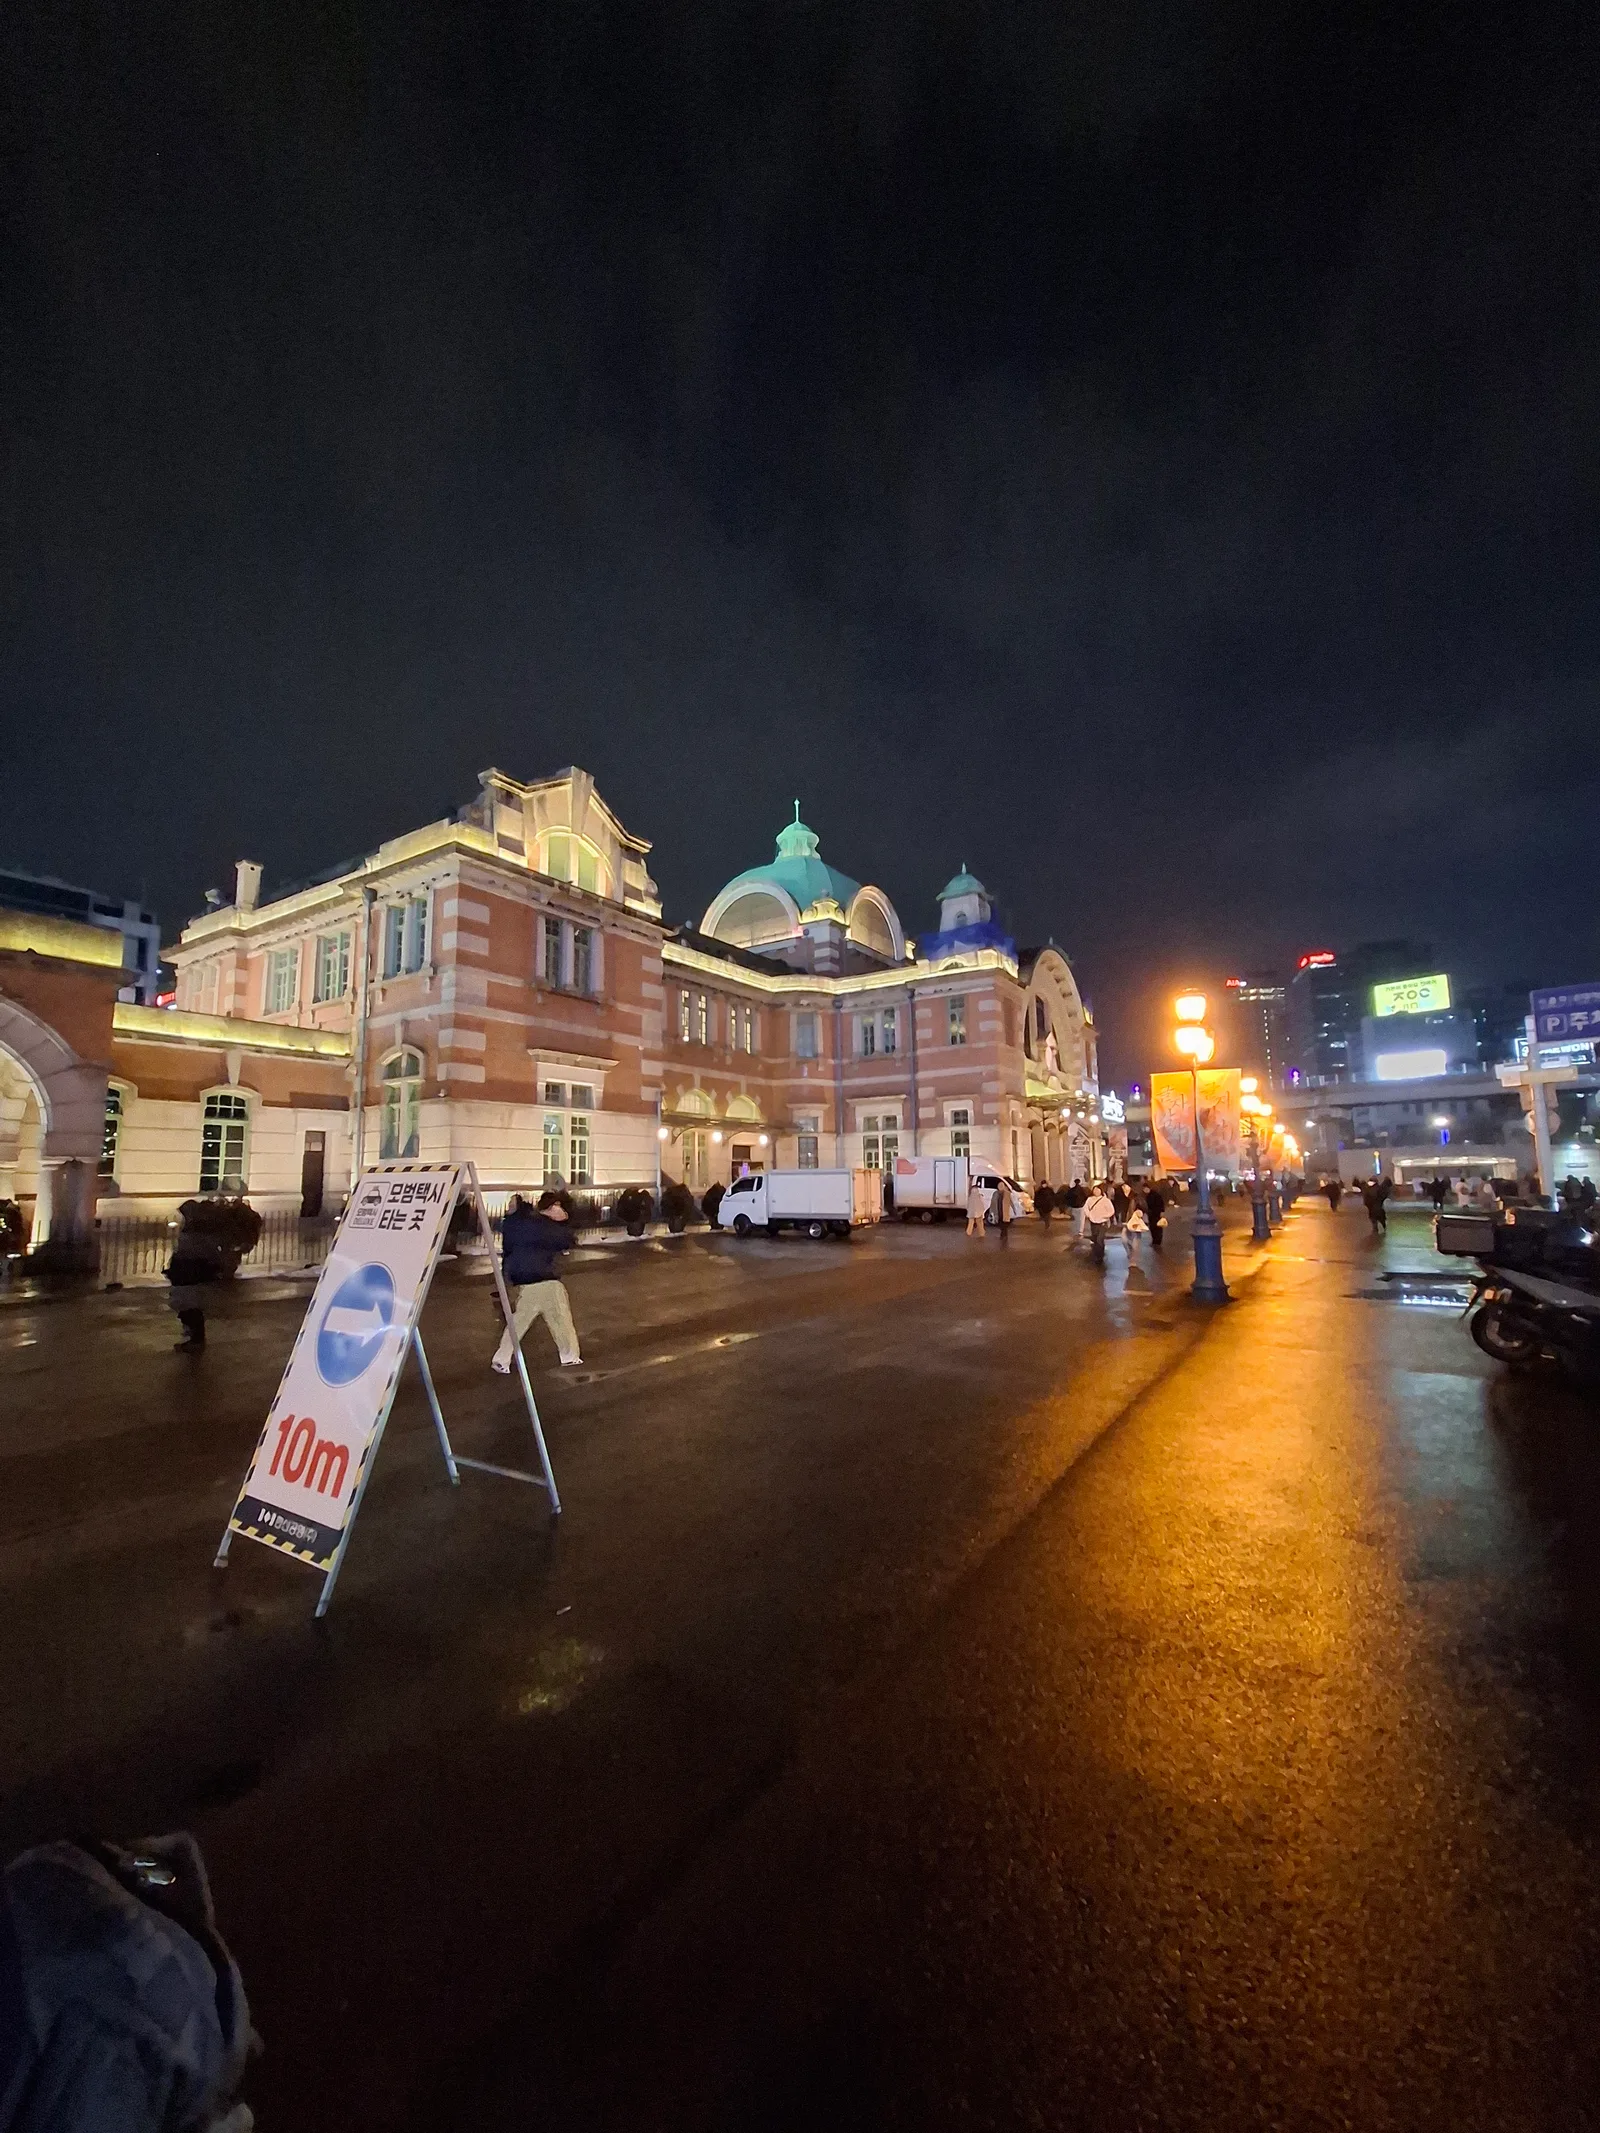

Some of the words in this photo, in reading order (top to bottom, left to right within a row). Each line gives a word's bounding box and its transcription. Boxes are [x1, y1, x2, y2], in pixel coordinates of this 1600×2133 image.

[1547, 1016, 1560, 1032] P
[387, 1182, 446, 1204] 모범택시
[378, 1209, 408, 1231] 타는
[408, 1209, 426, 1231] 곳
[269, 1414, 350, 1499] 10m
